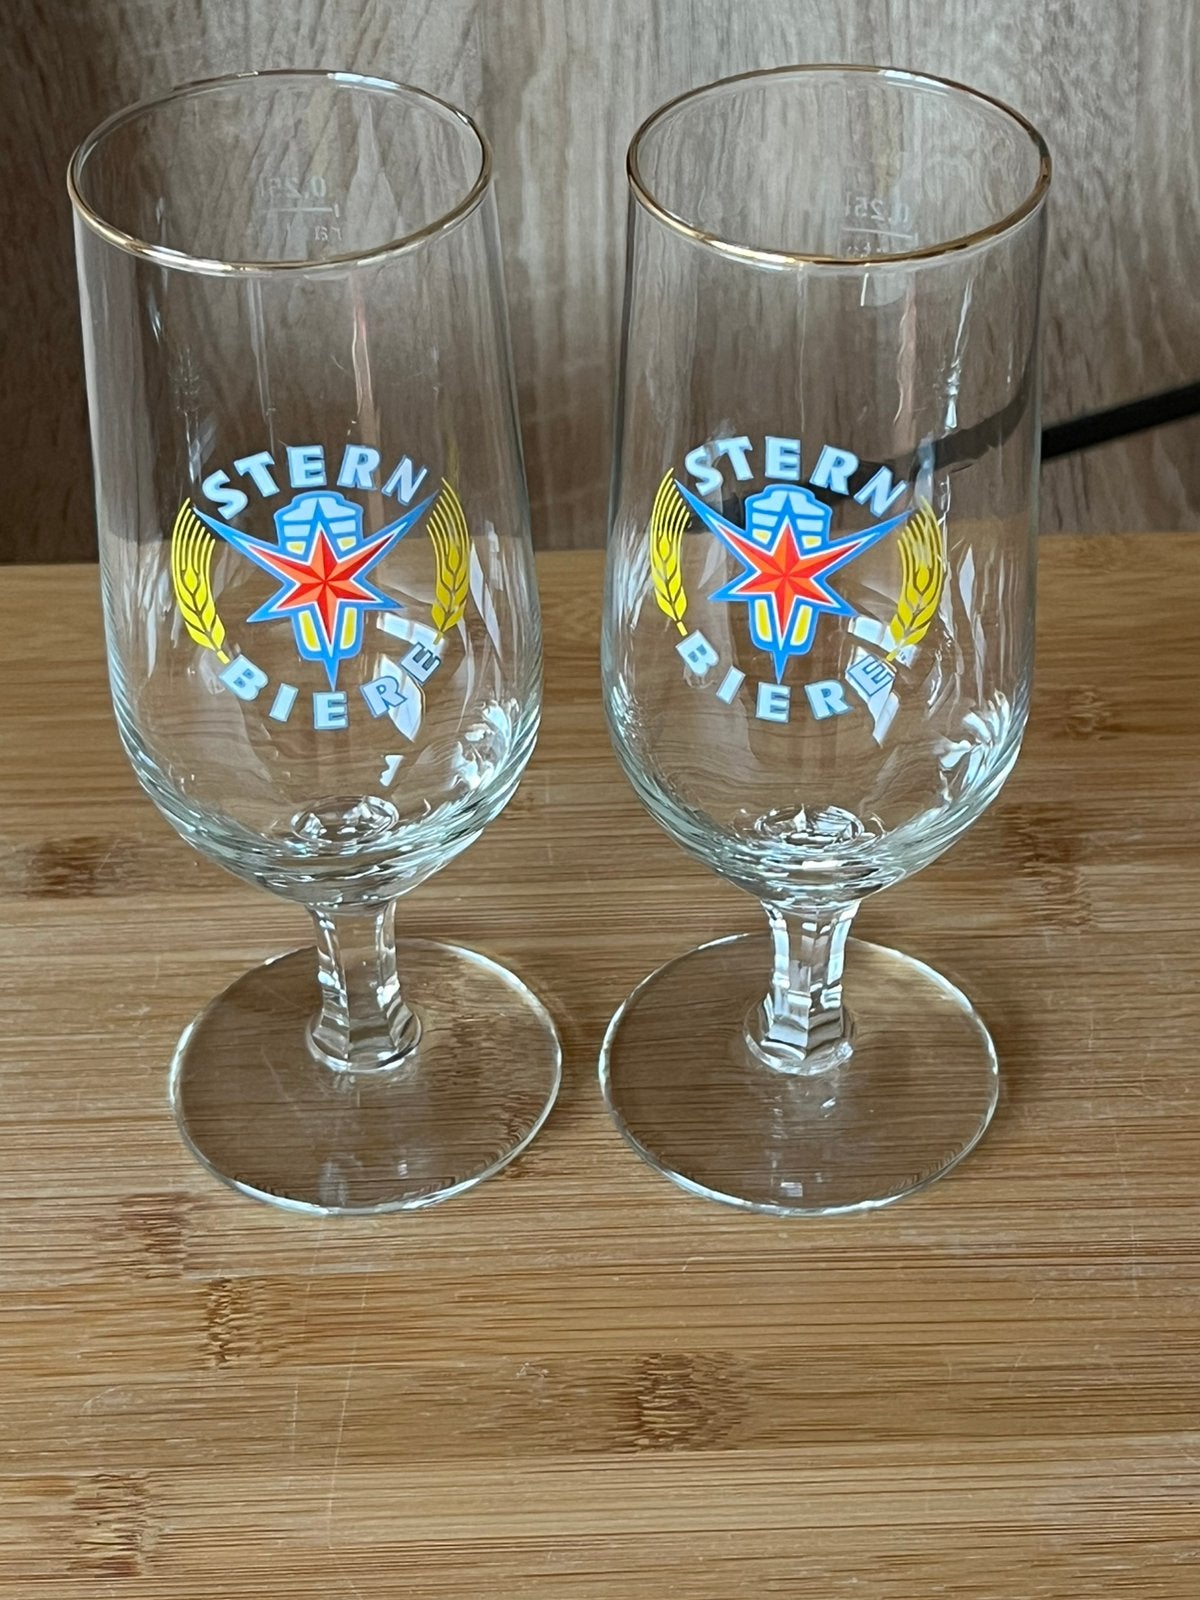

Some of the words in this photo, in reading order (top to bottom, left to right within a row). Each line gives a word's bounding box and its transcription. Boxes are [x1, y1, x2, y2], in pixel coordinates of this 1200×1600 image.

[202, 444, 428, 520] STERN
[684, 435, 909, 517] STERN
[219, 642, 441, 730] BIERE
[675, 630, 896, 723] BIERE
